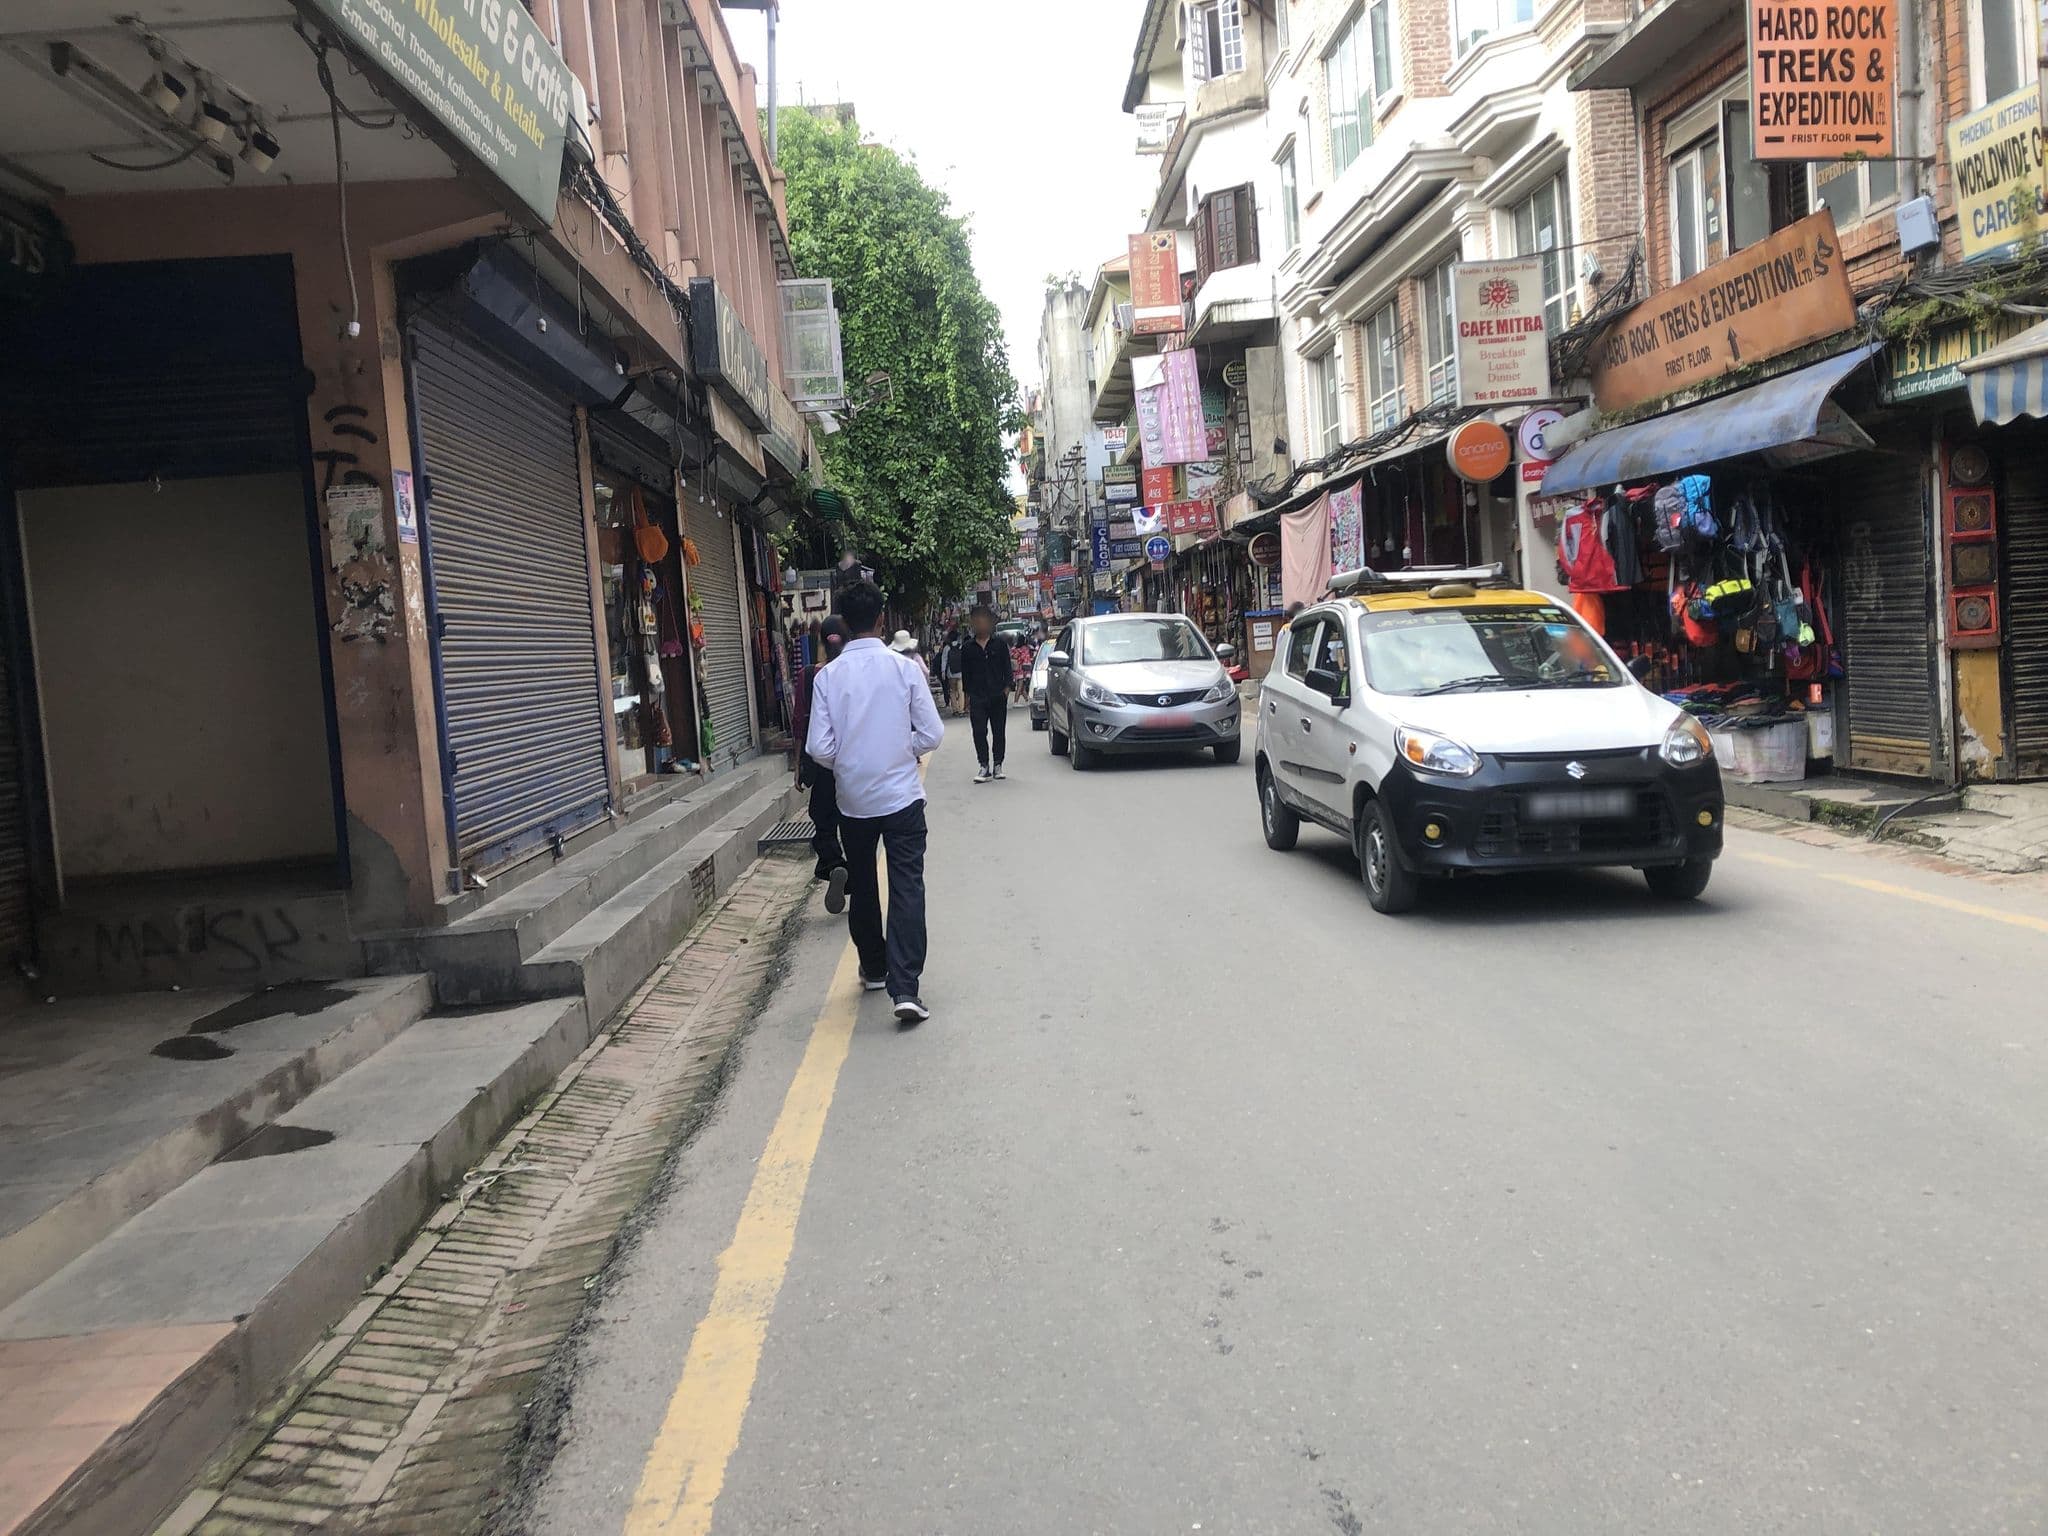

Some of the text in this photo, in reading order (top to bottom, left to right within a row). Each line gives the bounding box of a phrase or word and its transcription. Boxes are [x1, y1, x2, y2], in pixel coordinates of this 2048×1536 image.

[341, 0, 379, 48] E-mail:
[1758, 5, 1887, 41] HARD ROCK
[503, 8, 519, 65] &
[521, 32, 568, 128] Crafts
[1758, 48, 1885, 83] TREKS &
[409, 31, 446, 87] Thamel,
[447, 73, 495, 136] Kathmandu,
[495, 124, 517, 158] Nepal
[491, 70, 502, 102] &
[503, 82, 545, 150] Retailer
[1759, 91, 1875, 126] EXPEDITION
[1791, 133, 1852, 143] FRIST FLOOR
[1959, 94, 2040, 146] PHOENIX INTERNA
[1956, 131, 2031, 200] WORLDWIDE
[1973, 193, 2027, 239] CARG
[1798, 267, 1815, 289] LTD.
[1629, 317, 1660, 358] ROCK
[1659, 302, 1700, 345] TREKS
[1700, 294, 1712, 329] &
[1708, 252, 1800, 322] EXPEDITION
[1460, 315, 1544, 338] CAFE MITRA
[1480, 348, 1526, 361] Breakfast
[1488, 359, 1519, 371] Lunch
[1665, 345, 1713, 377] FIRST FLOOR
[1488, 373, 1521, 383] Dinner
[1097, 528, 1110, 568] CARGO
